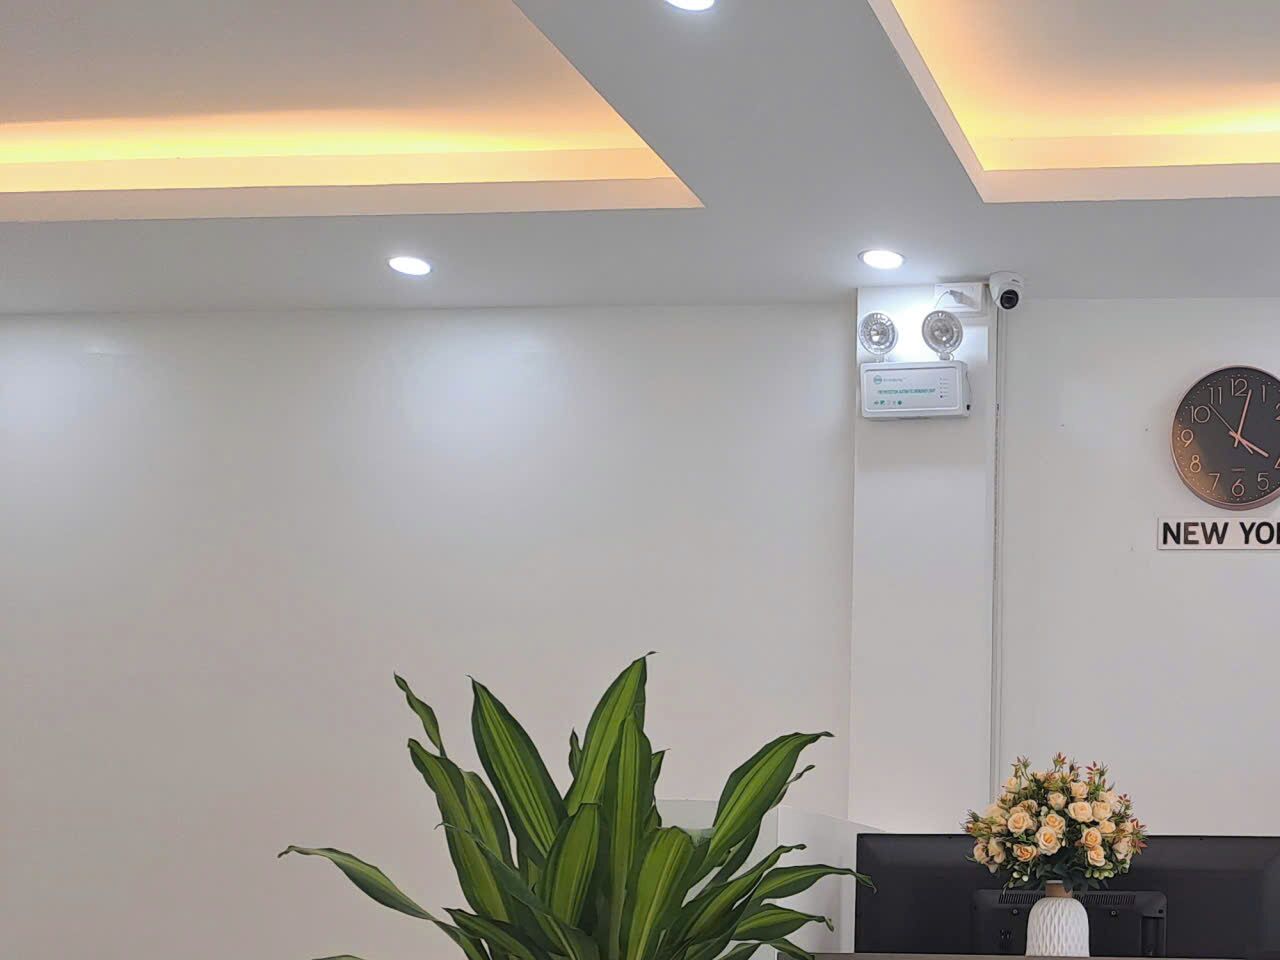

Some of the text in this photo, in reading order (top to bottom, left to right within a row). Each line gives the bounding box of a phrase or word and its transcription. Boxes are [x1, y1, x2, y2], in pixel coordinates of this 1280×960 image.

[1209, 387, 1221, 404] 11
[1231, 379, 1247, 396] 12
[1262, 385, 1265, 402] 1
[1190, 406, 1210, 423] 10
[1181, 430, 1193, 447] 9
[1190, 455, 1201, 472] 8
[1208, 473, 1220, 490] 7
[1232, 479, 1244, 496] 6
[1258, 473, 1269, 490] 5
[1163, 522, 1229, 544] NEW
